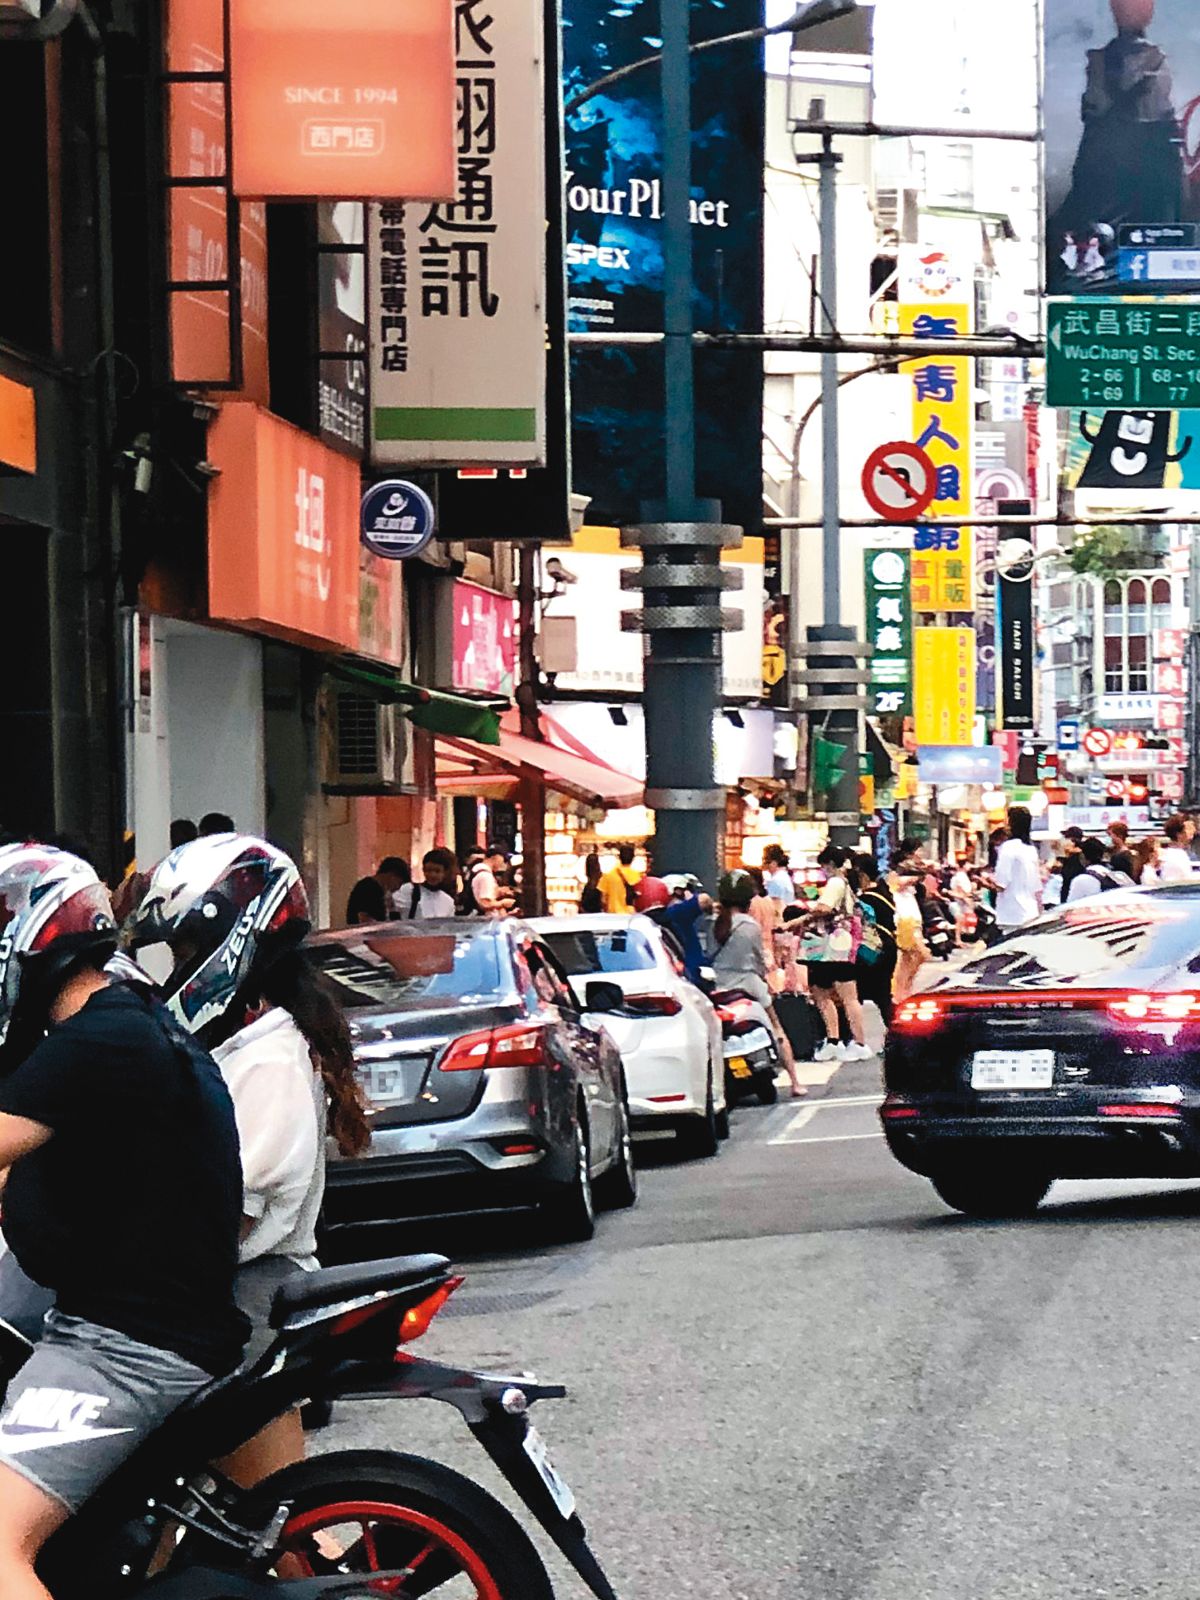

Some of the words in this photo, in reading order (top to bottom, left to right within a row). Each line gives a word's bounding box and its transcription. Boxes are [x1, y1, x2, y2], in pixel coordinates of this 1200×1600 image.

[285, 87, 342, 104] SINCE
[353, 87, 398, 103] 1994
[310, 126, 374, 148] 西門店
[628, 178, 729, 228] Plet
[1065, 345, 1139, 364] WuChang
[1169, 387, 1188, 400] 77
[876, 691, 905, 711] 2F
[4, 1387, 110, 1427] NIKE
